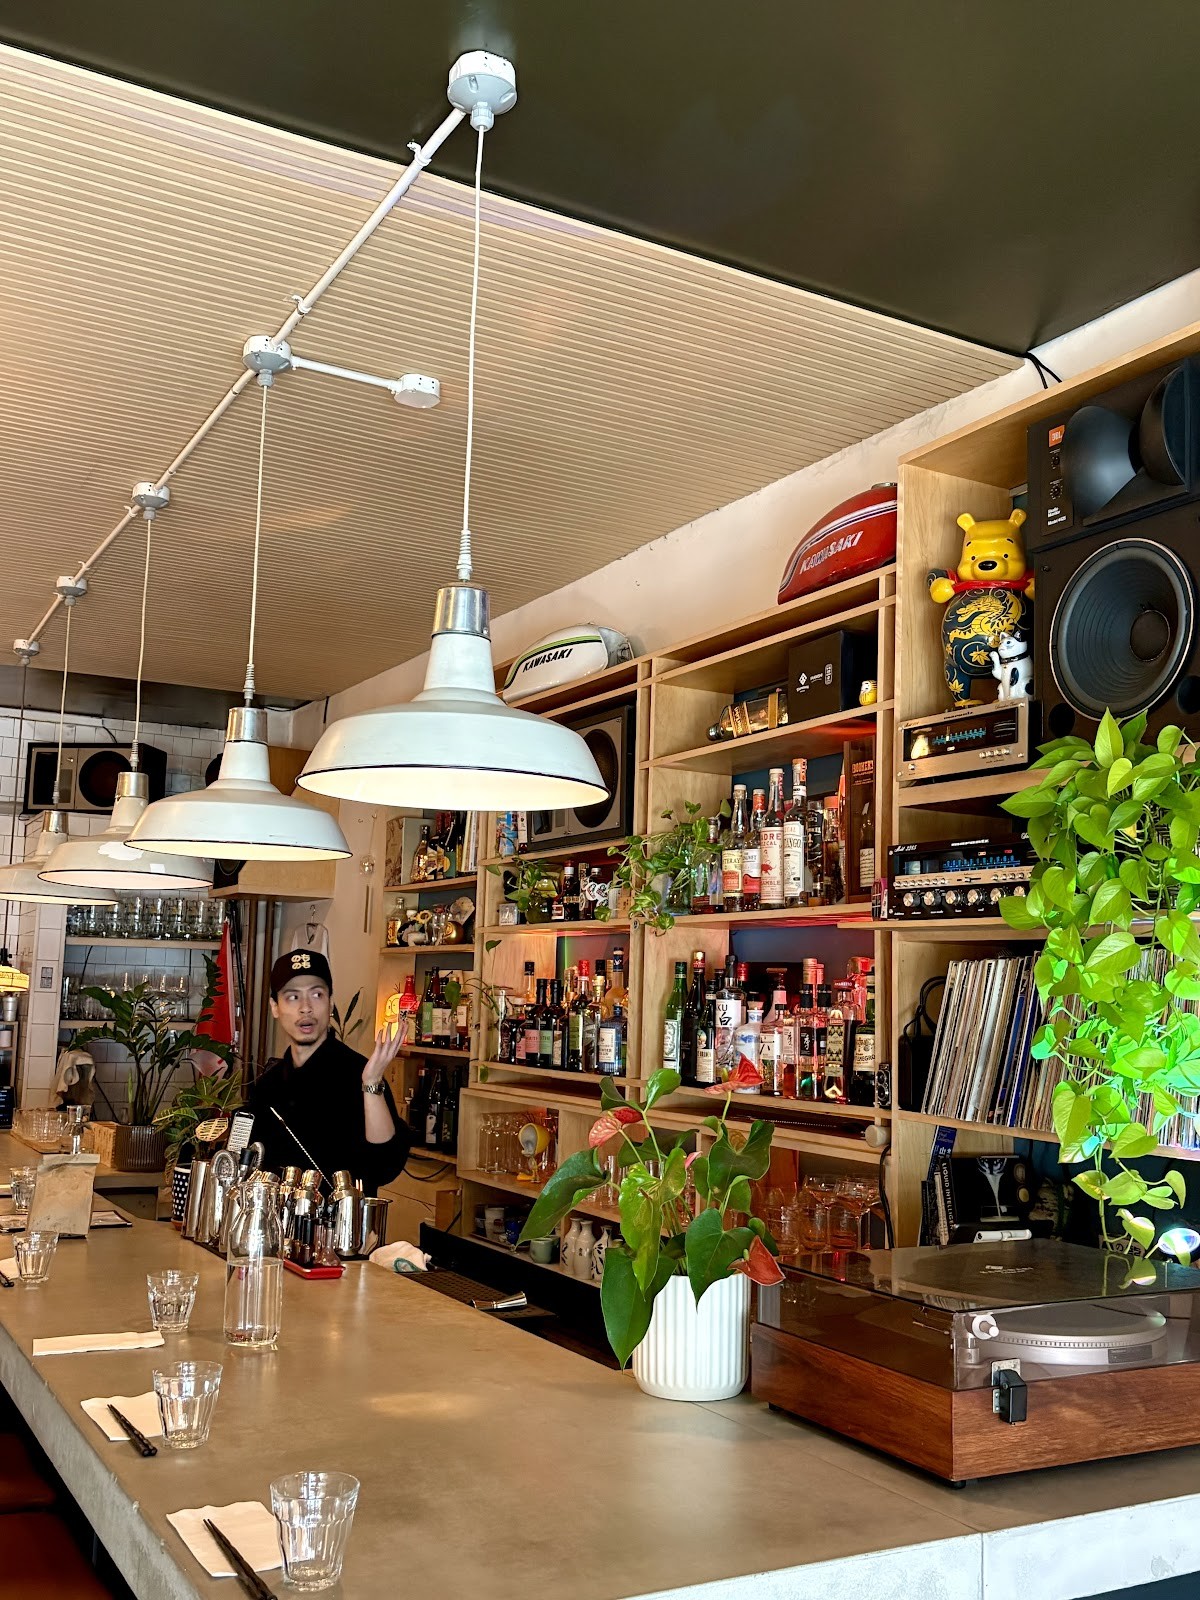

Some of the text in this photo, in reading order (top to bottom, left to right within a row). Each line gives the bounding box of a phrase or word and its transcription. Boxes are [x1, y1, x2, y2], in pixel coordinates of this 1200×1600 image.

[1051, 431, 1063, 442] JBL
[800, 531, 864, 575] KAWASAKI
[522, 648, 573, 673] KAWASAKI
[719, 1012, 733, 1026] 白
[941, 1162, 950, 1188] LIQUID
